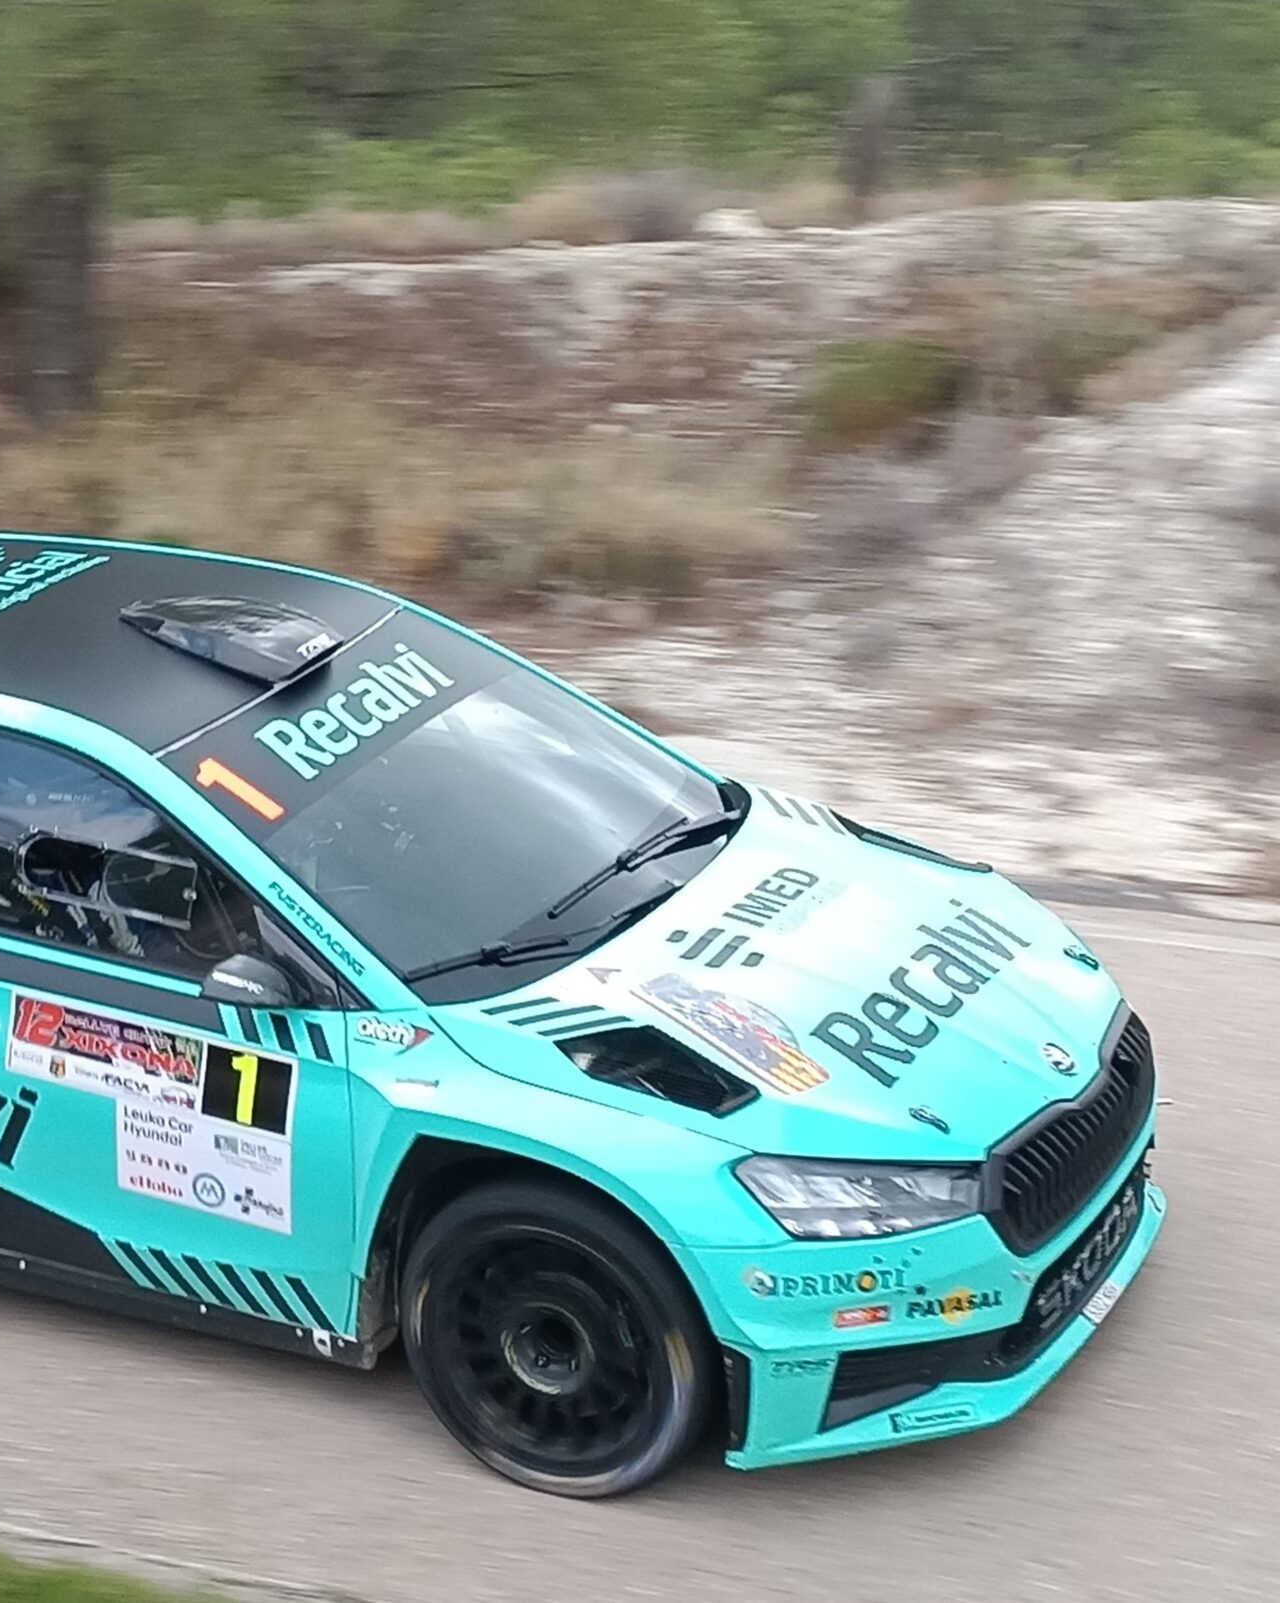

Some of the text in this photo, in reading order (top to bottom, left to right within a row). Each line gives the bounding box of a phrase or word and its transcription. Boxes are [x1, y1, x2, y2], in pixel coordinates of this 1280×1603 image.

[253, 642, 455, 781] Recalvi
[195, 757, 285, 820] 1
[722, 868, 819, 928] IMED
[15, 999, 64, 1047] 12
[809, 899, 1031, 1089] Recalvi
[123, 1105, 165, 1126] Leuka
[231, 1055, 259, 1126] 1
[123, 1121, 183, 1147] Hyundai
